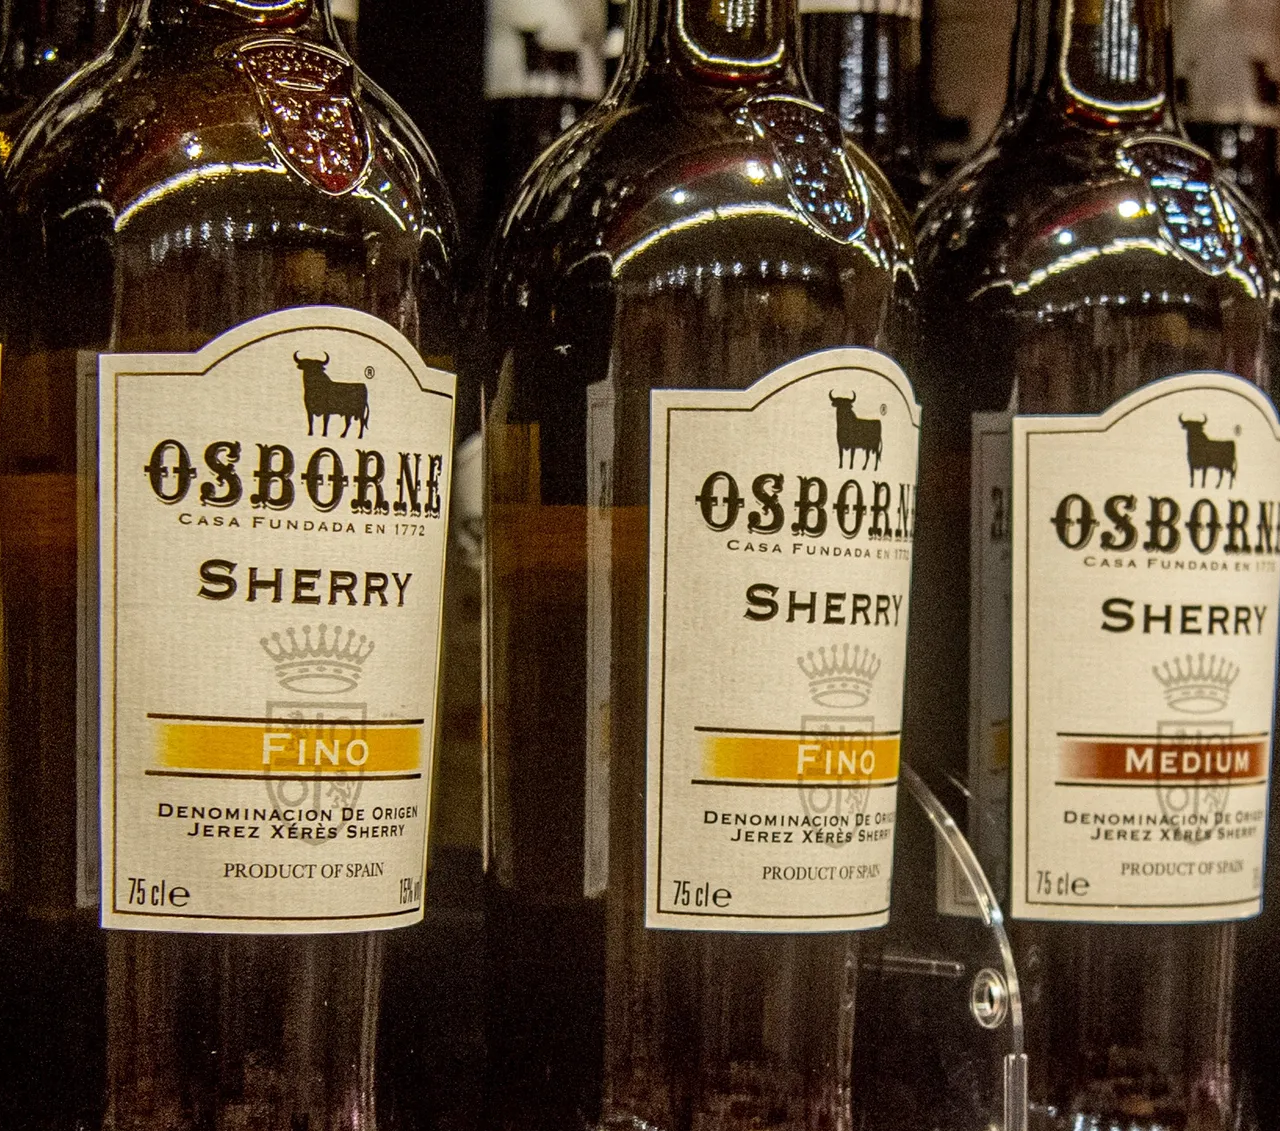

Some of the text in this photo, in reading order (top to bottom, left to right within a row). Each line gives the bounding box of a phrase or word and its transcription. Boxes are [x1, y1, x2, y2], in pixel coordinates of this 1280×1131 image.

[144, 439, 443, 519] OSBORNE
[178, 513, 425, 537] CASA FUNDADA EN 1772
[726, 540, 782, 554] CASA
[792, 543, 871, 558] FUNDADA
[1083, 556, 1136, 568] CASA
[1147, 559, 1228, 571] FUNDADA
[197, 558, 412, 607] SHERRY
[743, 583, 902, 627] SHERRY
[1101, 598, 1267, 635] SHERRY
[262, 732, 370, 766] FINO
[797, 745, 875, 775] FINO
[1125, 748, 1250, 774] MEDIUM
[158, 803, 418, 821] DENOMINACION DE ORIGEN
[703, 811, 849, 827] DENOMINACION
[856, 813, 870, 826] DE
[1064, 810, 1209, 826] DENOMINACION
[187, 823, 260, 838] JEREZ
[347, 823, 405, 838] SHERRY
[730, 829, 793, 843] JEREZ
[1091, 828, 1152, 841] JEREZ
[224, 862, 384, 879] PRODUCT OF SPAIN
[762, 866, 837, 880] PRODUCT
[839, 866, 855, 879] OF
[1121, 861, 1195, 877] PRODUCT
[1198, 861, 1214, 875] OF
[129, 878, 146, 905] 75
[1036, 870, 1052, 895] 75
[673, 881, 691, 907] 75
